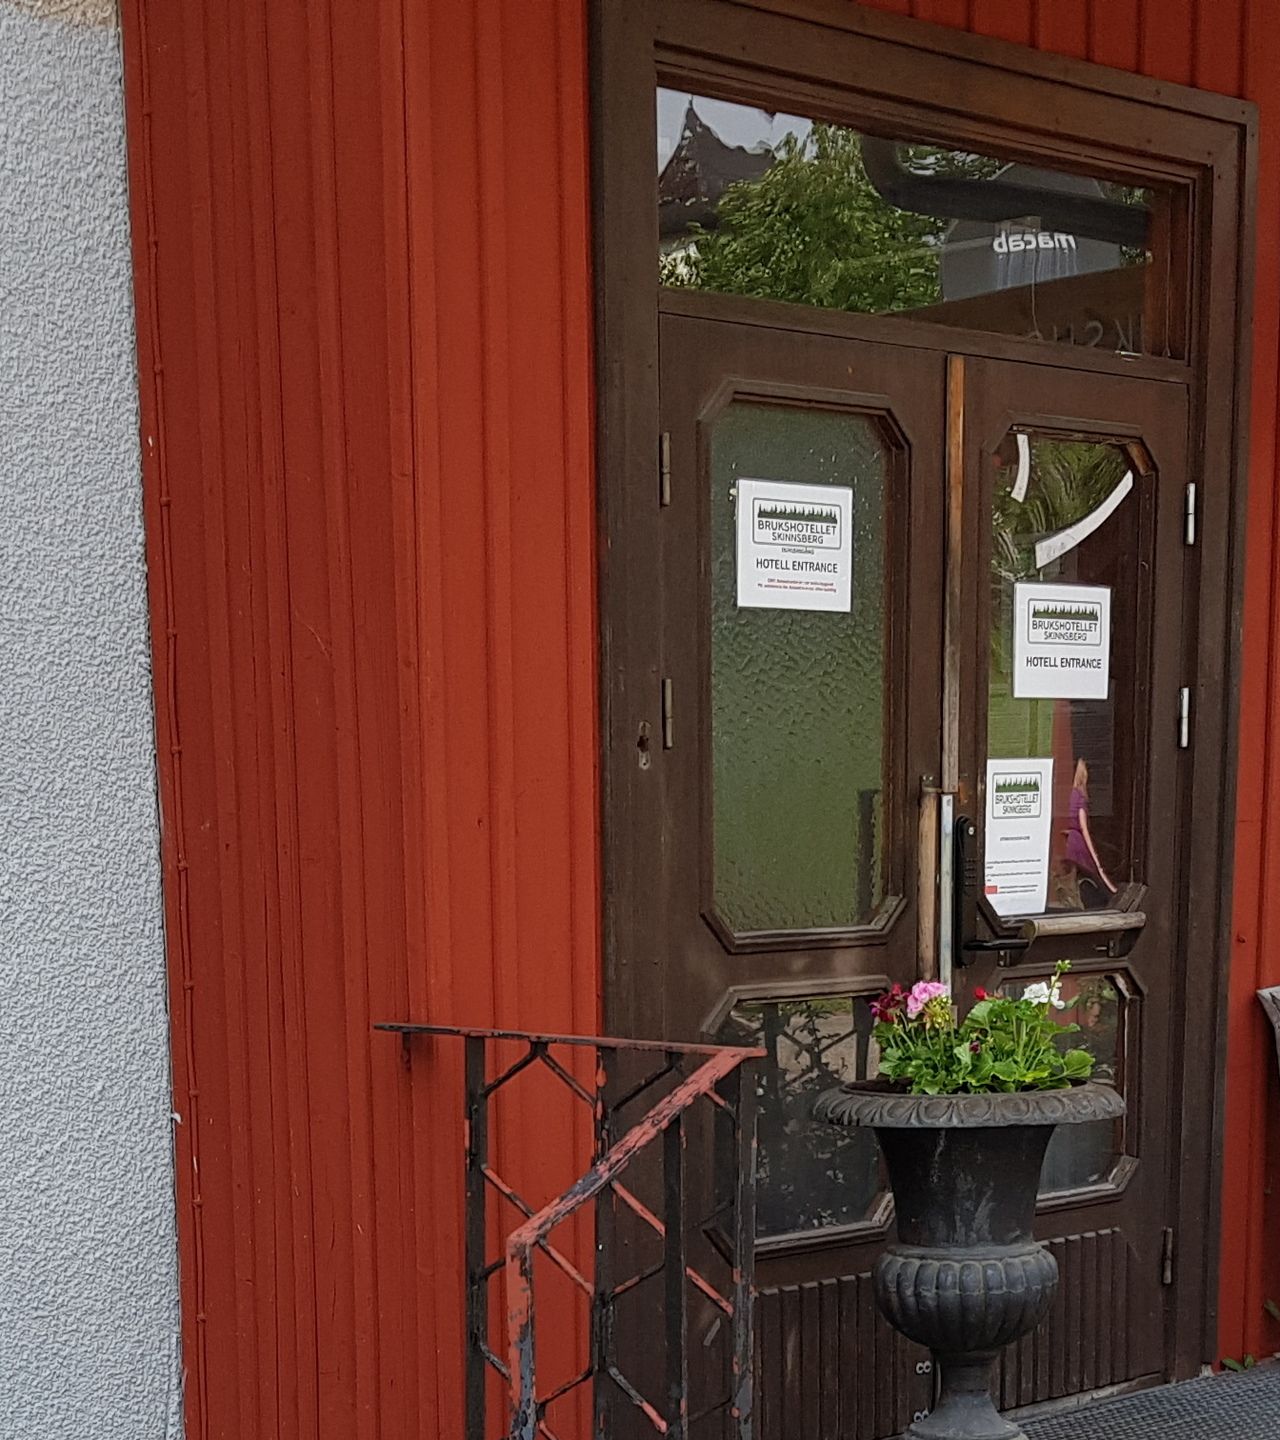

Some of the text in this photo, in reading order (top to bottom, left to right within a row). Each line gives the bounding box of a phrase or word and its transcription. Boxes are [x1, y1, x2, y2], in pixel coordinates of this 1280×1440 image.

[757, 519, 836, 536] BRUKSHOTELLET
[772, 532, 823, 544] SKINNSBERG
[756, 558, 838, 573] HOTELL ENTRANCE
[1032, 620, 1098, 632] BRUKSHOTELLET
[1044, 631, 1087, 641] SKINNSBERG
[1026, 656, 1101, 669] HOTELL ENTRANCE
